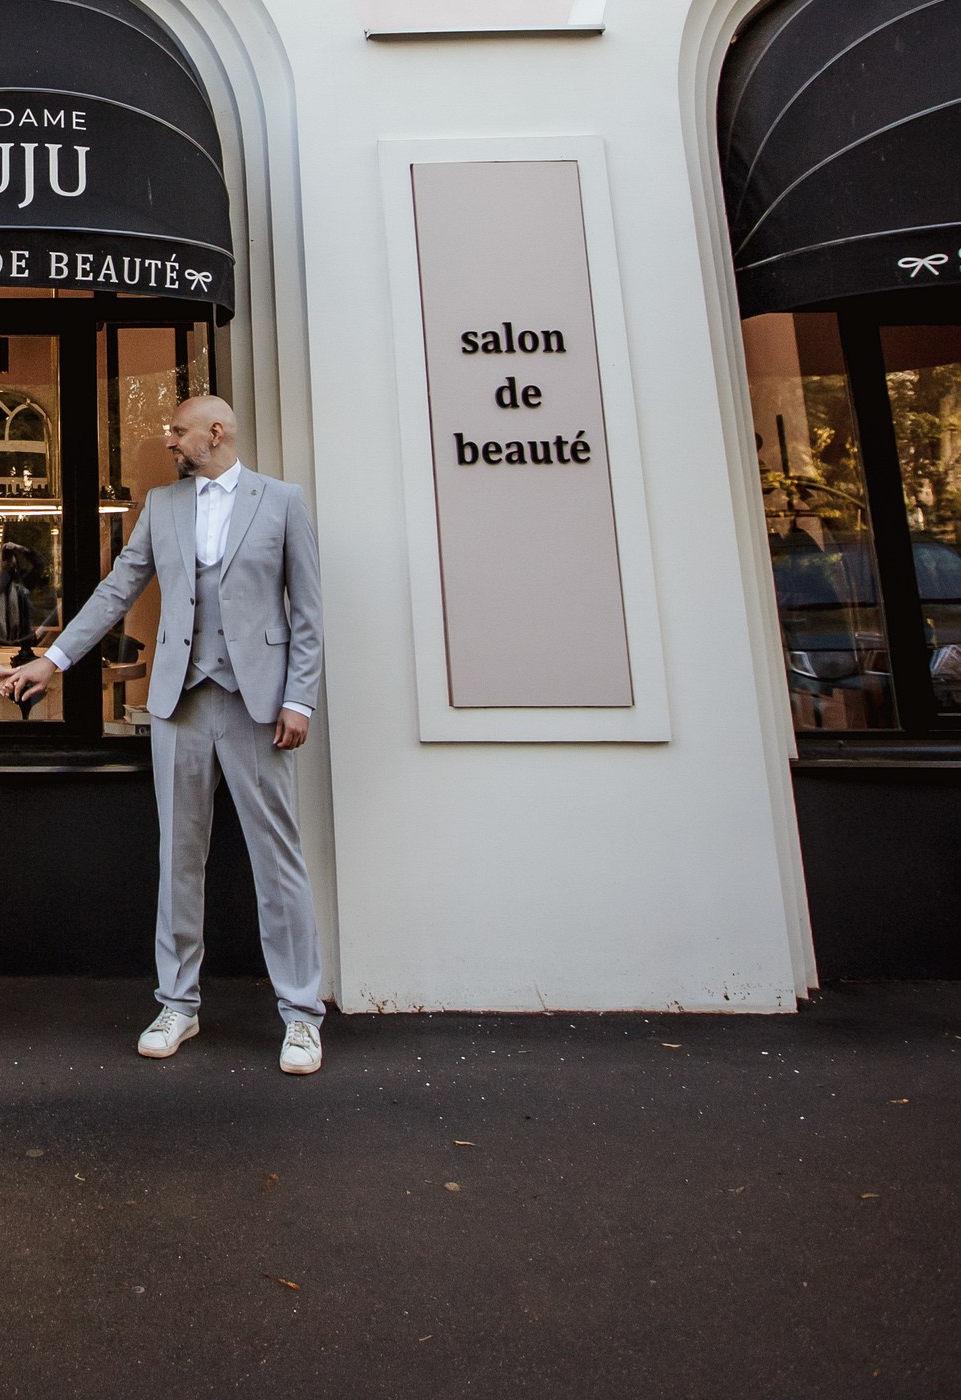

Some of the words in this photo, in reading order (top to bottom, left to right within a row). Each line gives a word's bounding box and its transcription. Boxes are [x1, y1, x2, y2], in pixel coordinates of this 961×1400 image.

[49, 251, 180, 289] BEAUTÉ
[461, 322, 567, 354] salon
[495, 376, 542, 409] de
[453, 430, 591, 465] beauté
